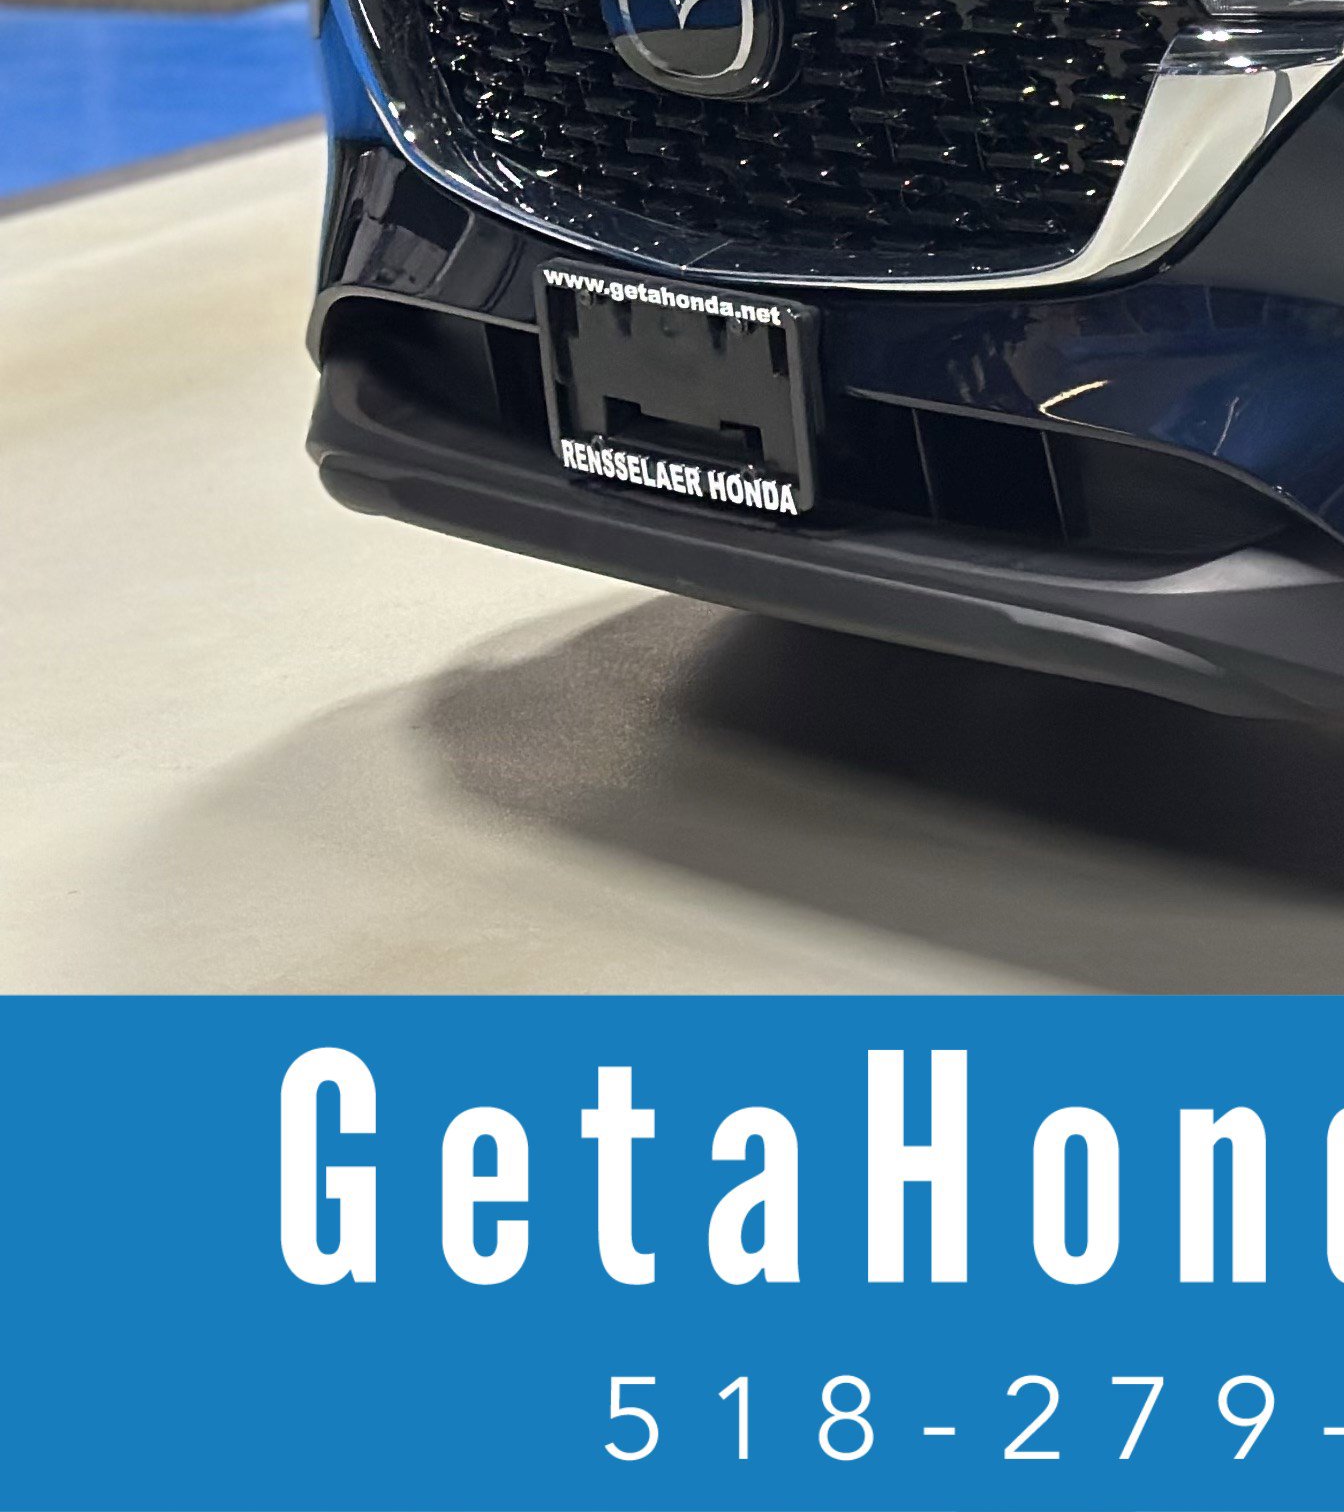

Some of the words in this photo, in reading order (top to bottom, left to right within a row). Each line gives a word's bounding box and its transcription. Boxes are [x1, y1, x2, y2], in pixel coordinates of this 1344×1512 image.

[543, 268, 782, 326] www.getahonda.net
[560, 438, 703, 498] RENSSELAER
[707, 469, 798, 516] HONDA
